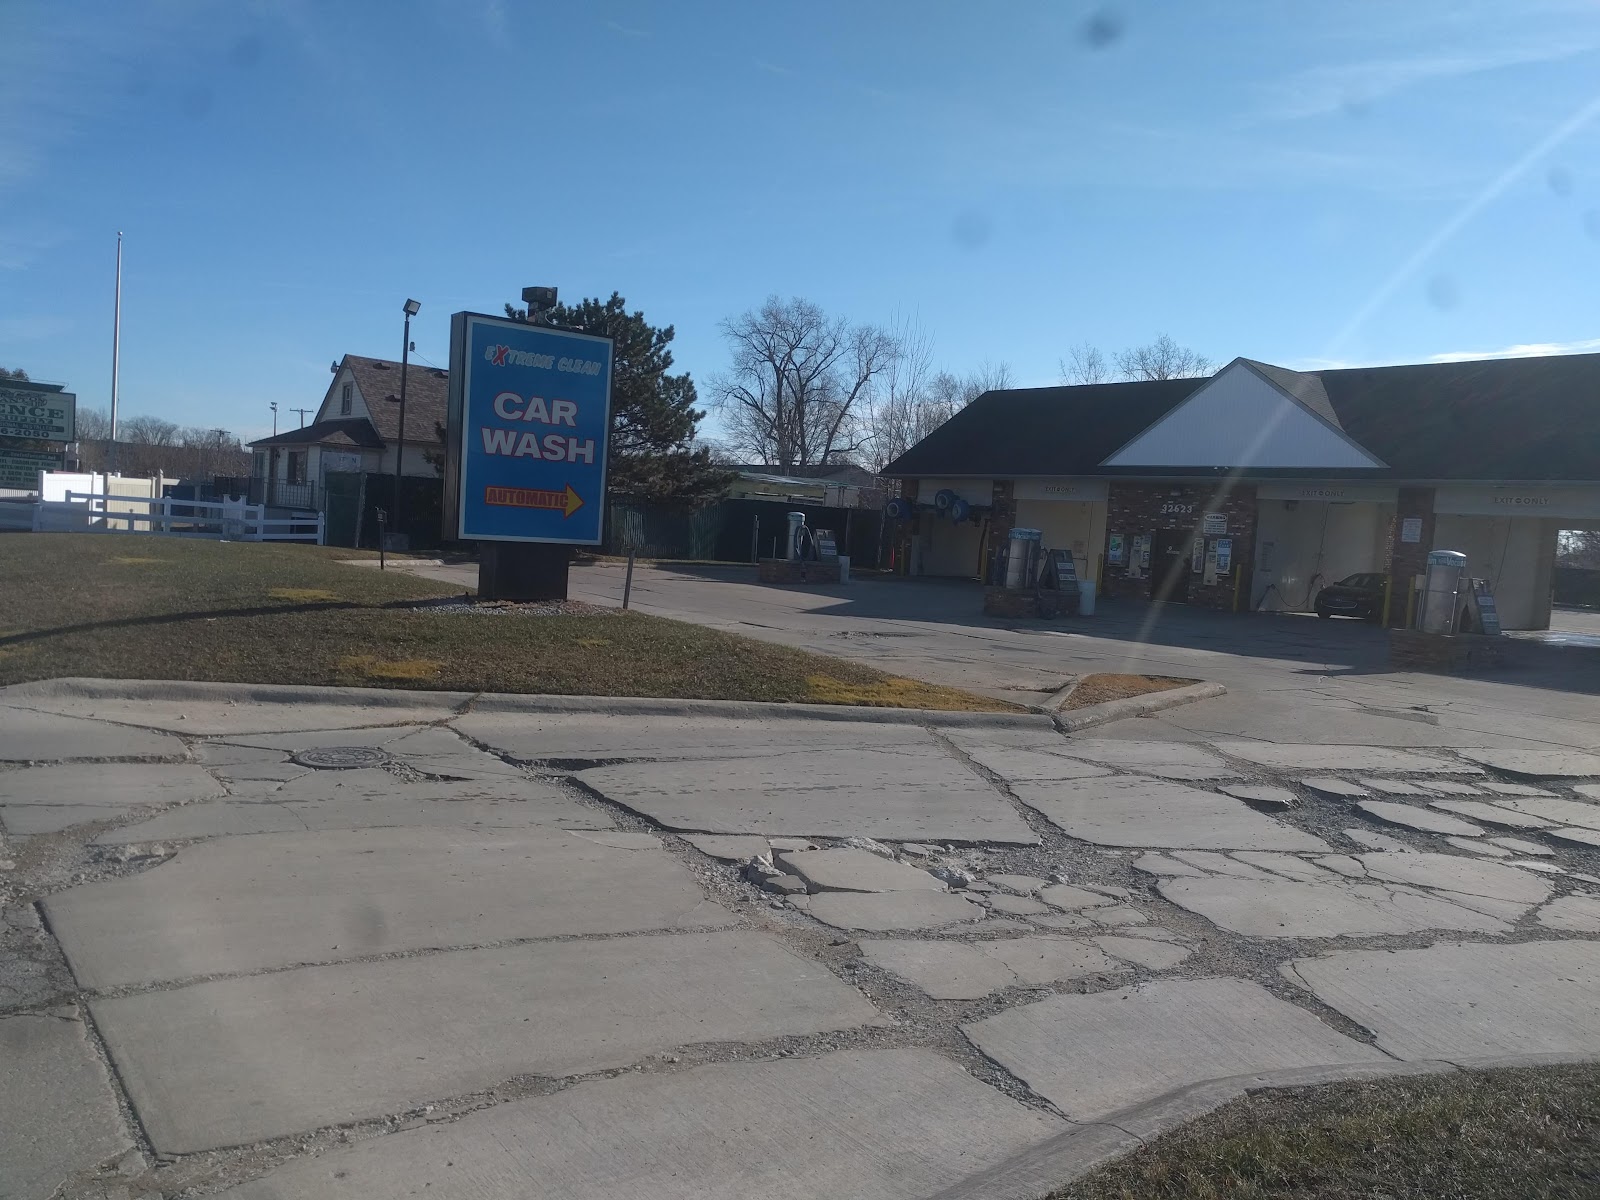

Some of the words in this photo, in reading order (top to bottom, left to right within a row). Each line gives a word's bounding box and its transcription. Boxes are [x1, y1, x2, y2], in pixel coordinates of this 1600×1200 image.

[484, 345, 555, 370] EXTREME
[557, 357, 601, 376] CLEAN
[493, 391, 579, 427] CAR
[481, 427, 595, 464] WASH
[487, 489, 569, 507] AUTOMATIC
[1161, 504, 1193, 514] 32623
[1523, 497, 1549, 505] ONLY
